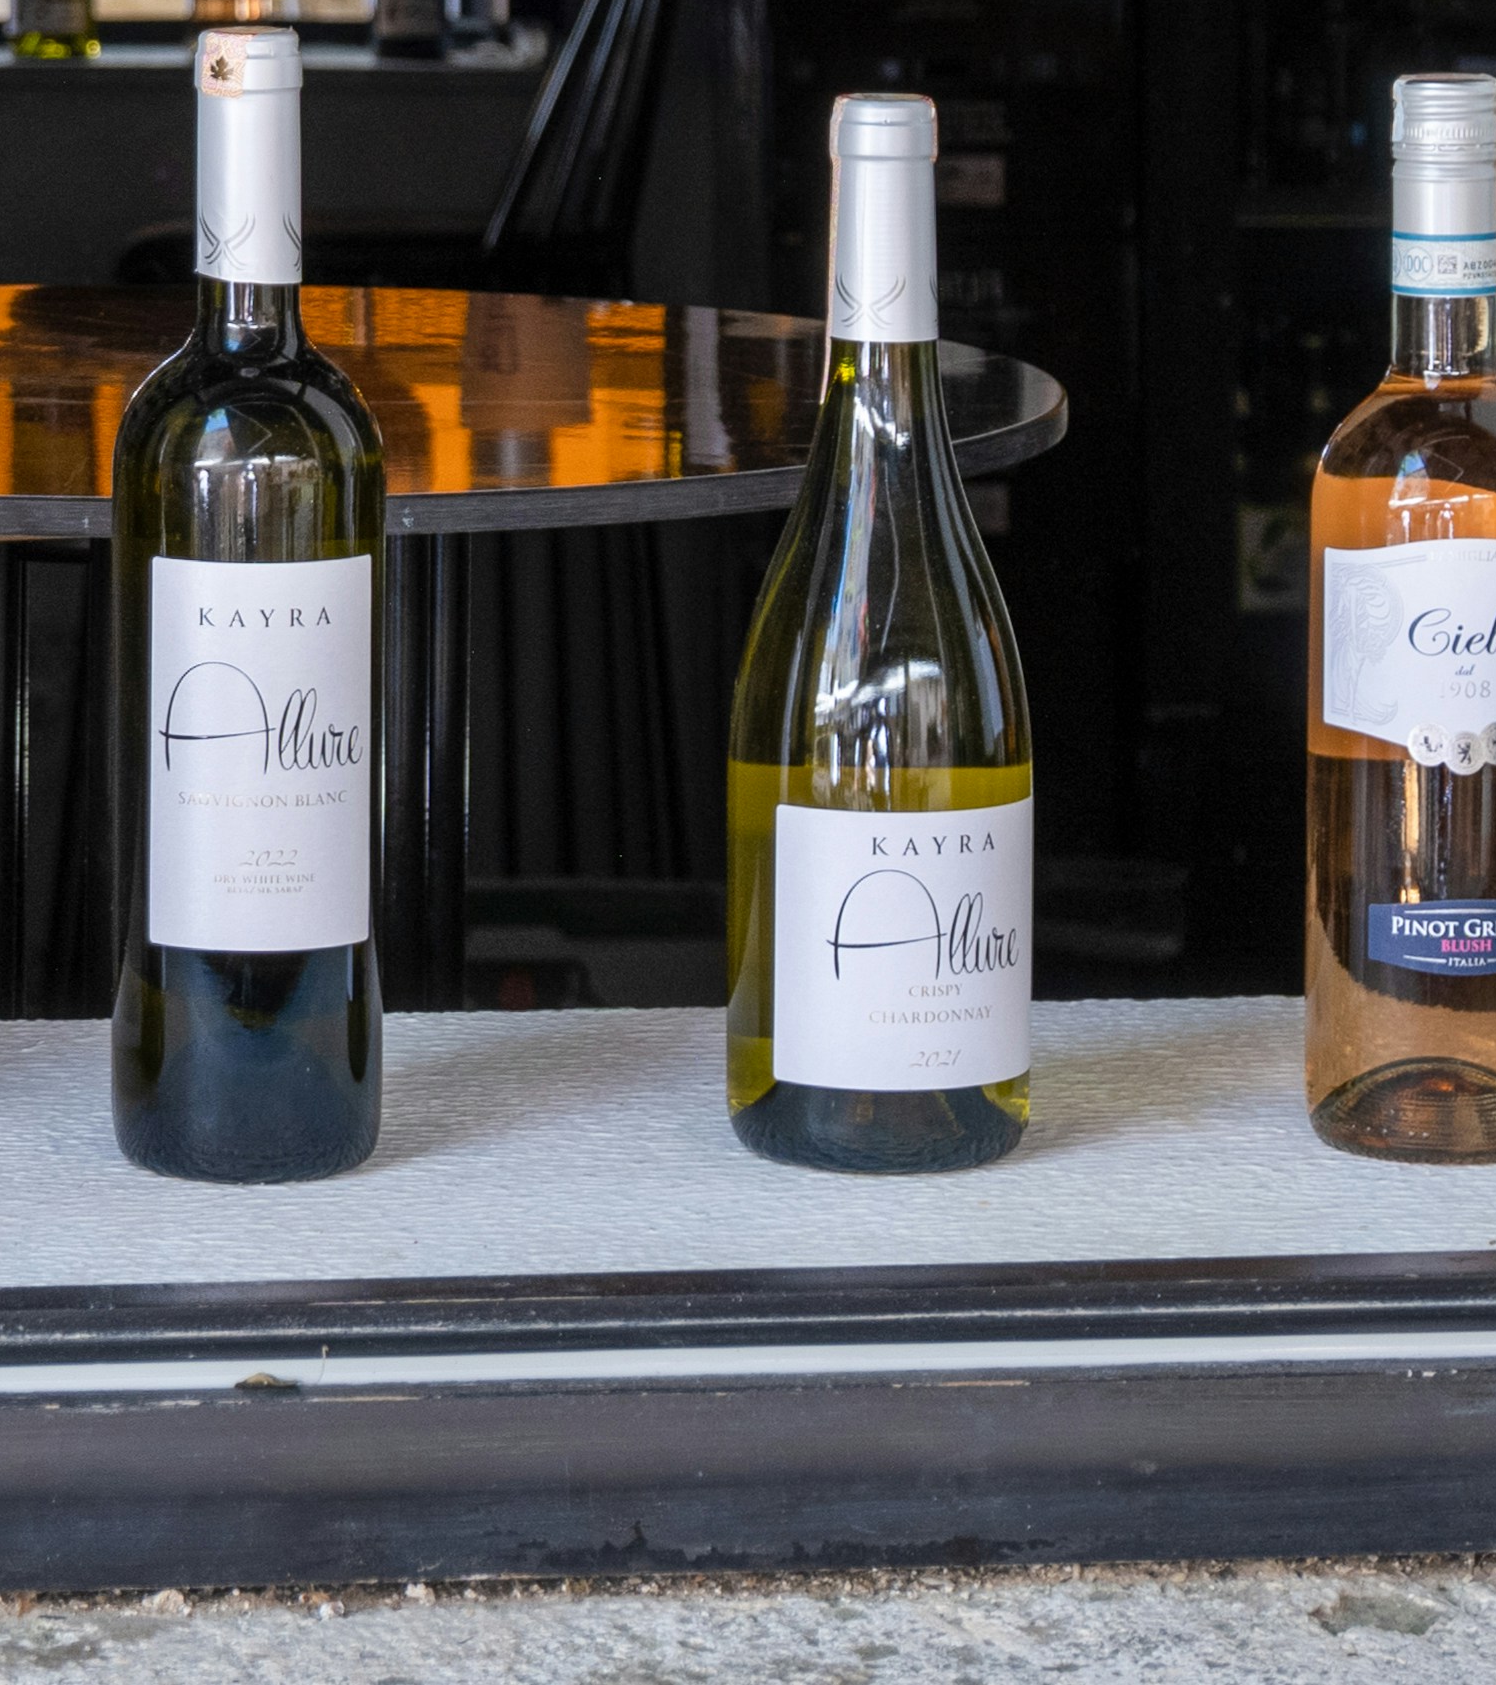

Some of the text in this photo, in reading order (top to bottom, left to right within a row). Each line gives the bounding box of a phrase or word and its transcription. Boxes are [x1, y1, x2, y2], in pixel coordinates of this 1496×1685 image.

[1407, 255, 1430, 273] DOC
[198, 606, 332, 628] KAYRA
[1454, 665, 1475, 677] dal
[159, 661, 364, 775] Allure
[178, 788, 348, 808] SAUVIGNON BLANC
[872, 832, 996, 856] KAYRA
[238, 849, 299, 868] 2022
[213, 872, 316, 884] DRY WHITE WINE
[826, 868, 1020, 981] Allure
[1391, 916, 1459, 938] PINOT
[1440, 938, 1493, 953] BLUSH
[1447, 956, 1487, 968] ITALIA
[908, 983, 963, 998] CRISPY
[868, 1005, 993, 1025] CHARDONNAY
[909, 1049, 962, 1067] 2021
